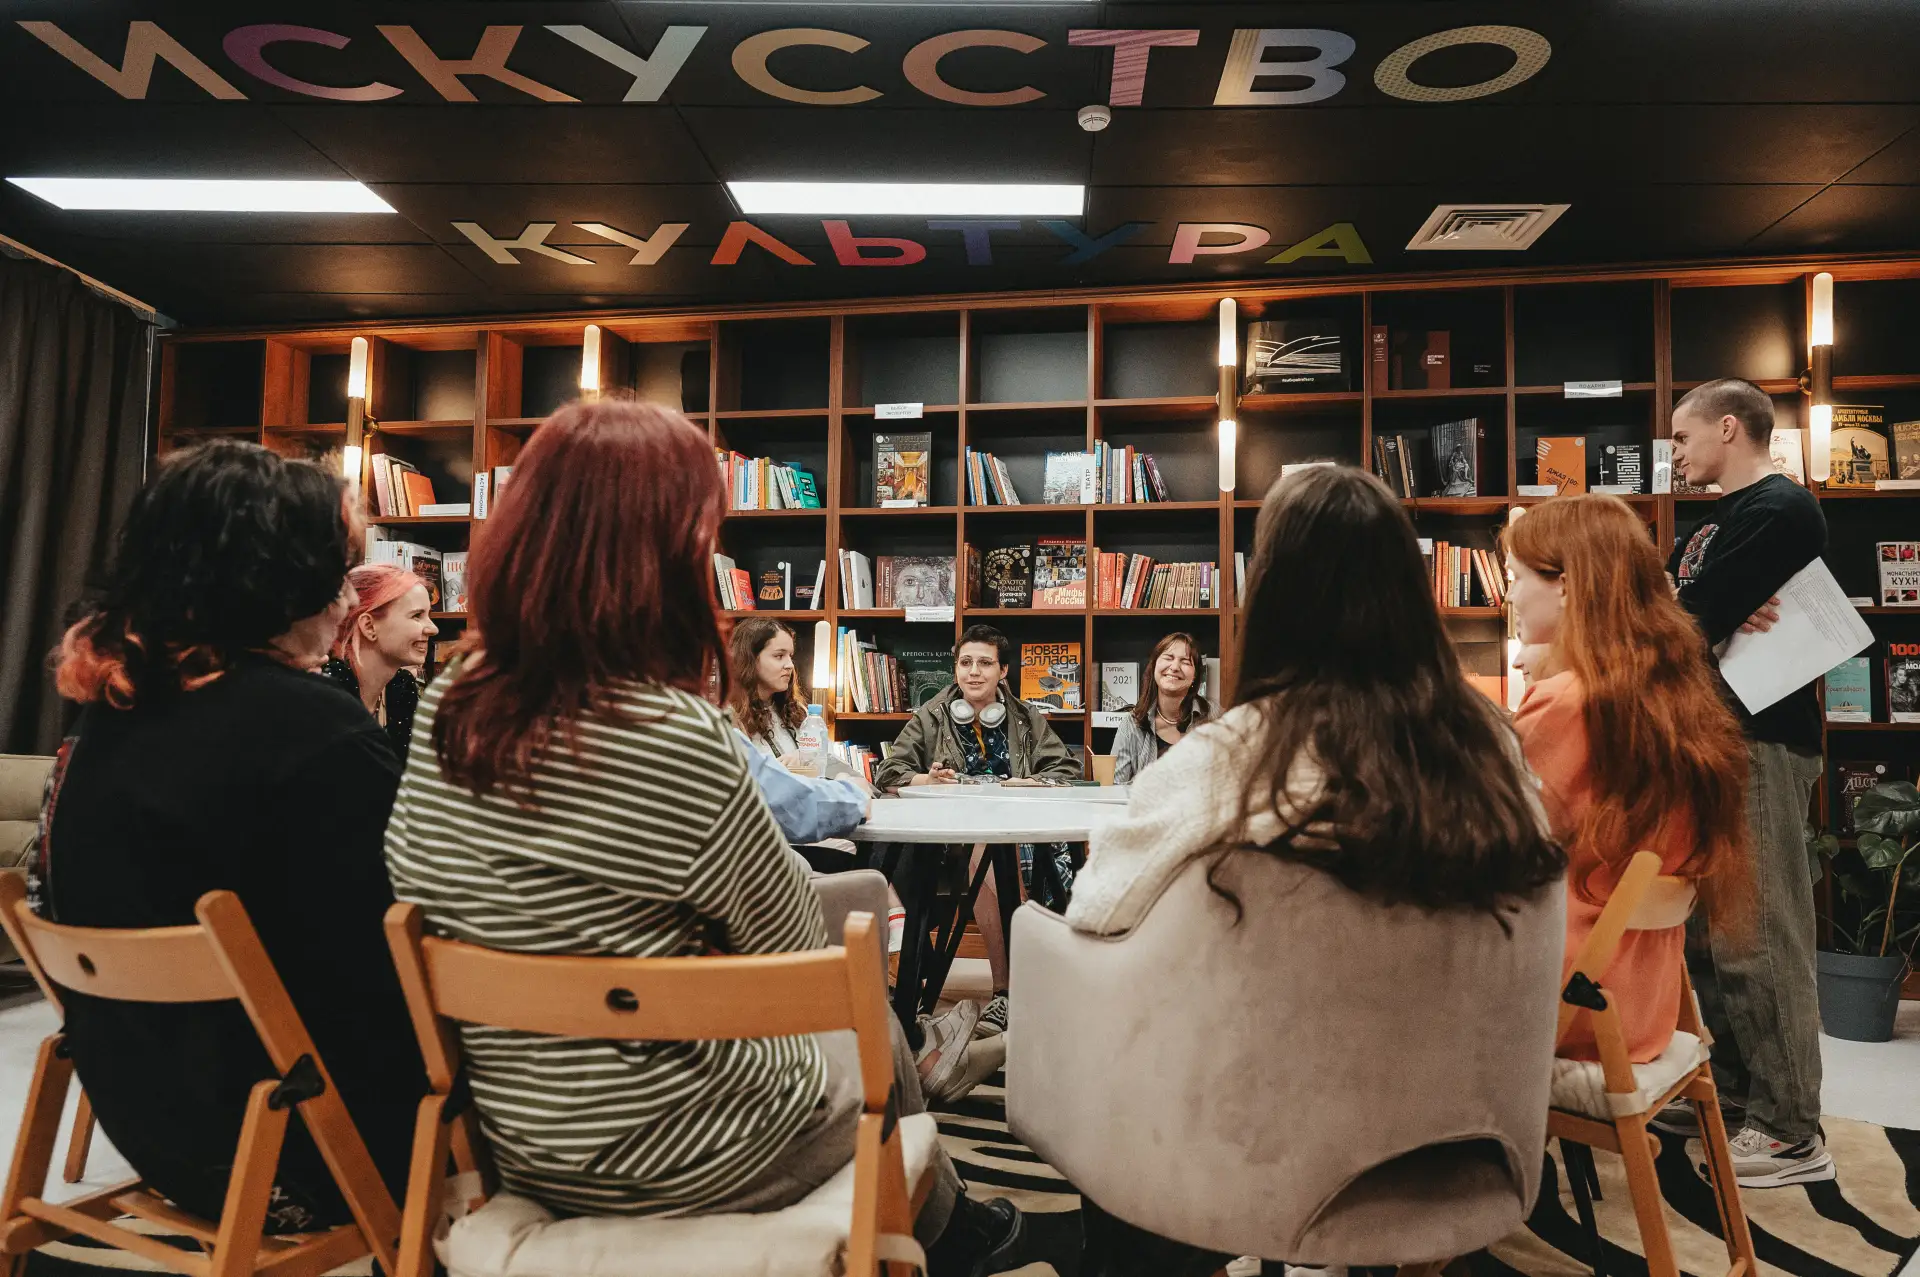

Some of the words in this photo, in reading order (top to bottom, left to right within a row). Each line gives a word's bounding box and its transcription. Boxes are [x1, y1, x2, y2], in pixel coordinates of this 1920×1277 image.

[14, 21, 1552, 107] ИСКУССТВО
[450, 218, 1374, 267] КУЛЬТУРА
[1832, 414, 1856, 422] САМБЛИ
[1857, 414, 1883, 422] МОСКВЫ
[1891, 577, 1920, 585] КУХН
[1059, 587, 1086, 599] Мифы
[1889, 643, 1920, 656] 100
[1113, 675, 1132, 685] 2021
